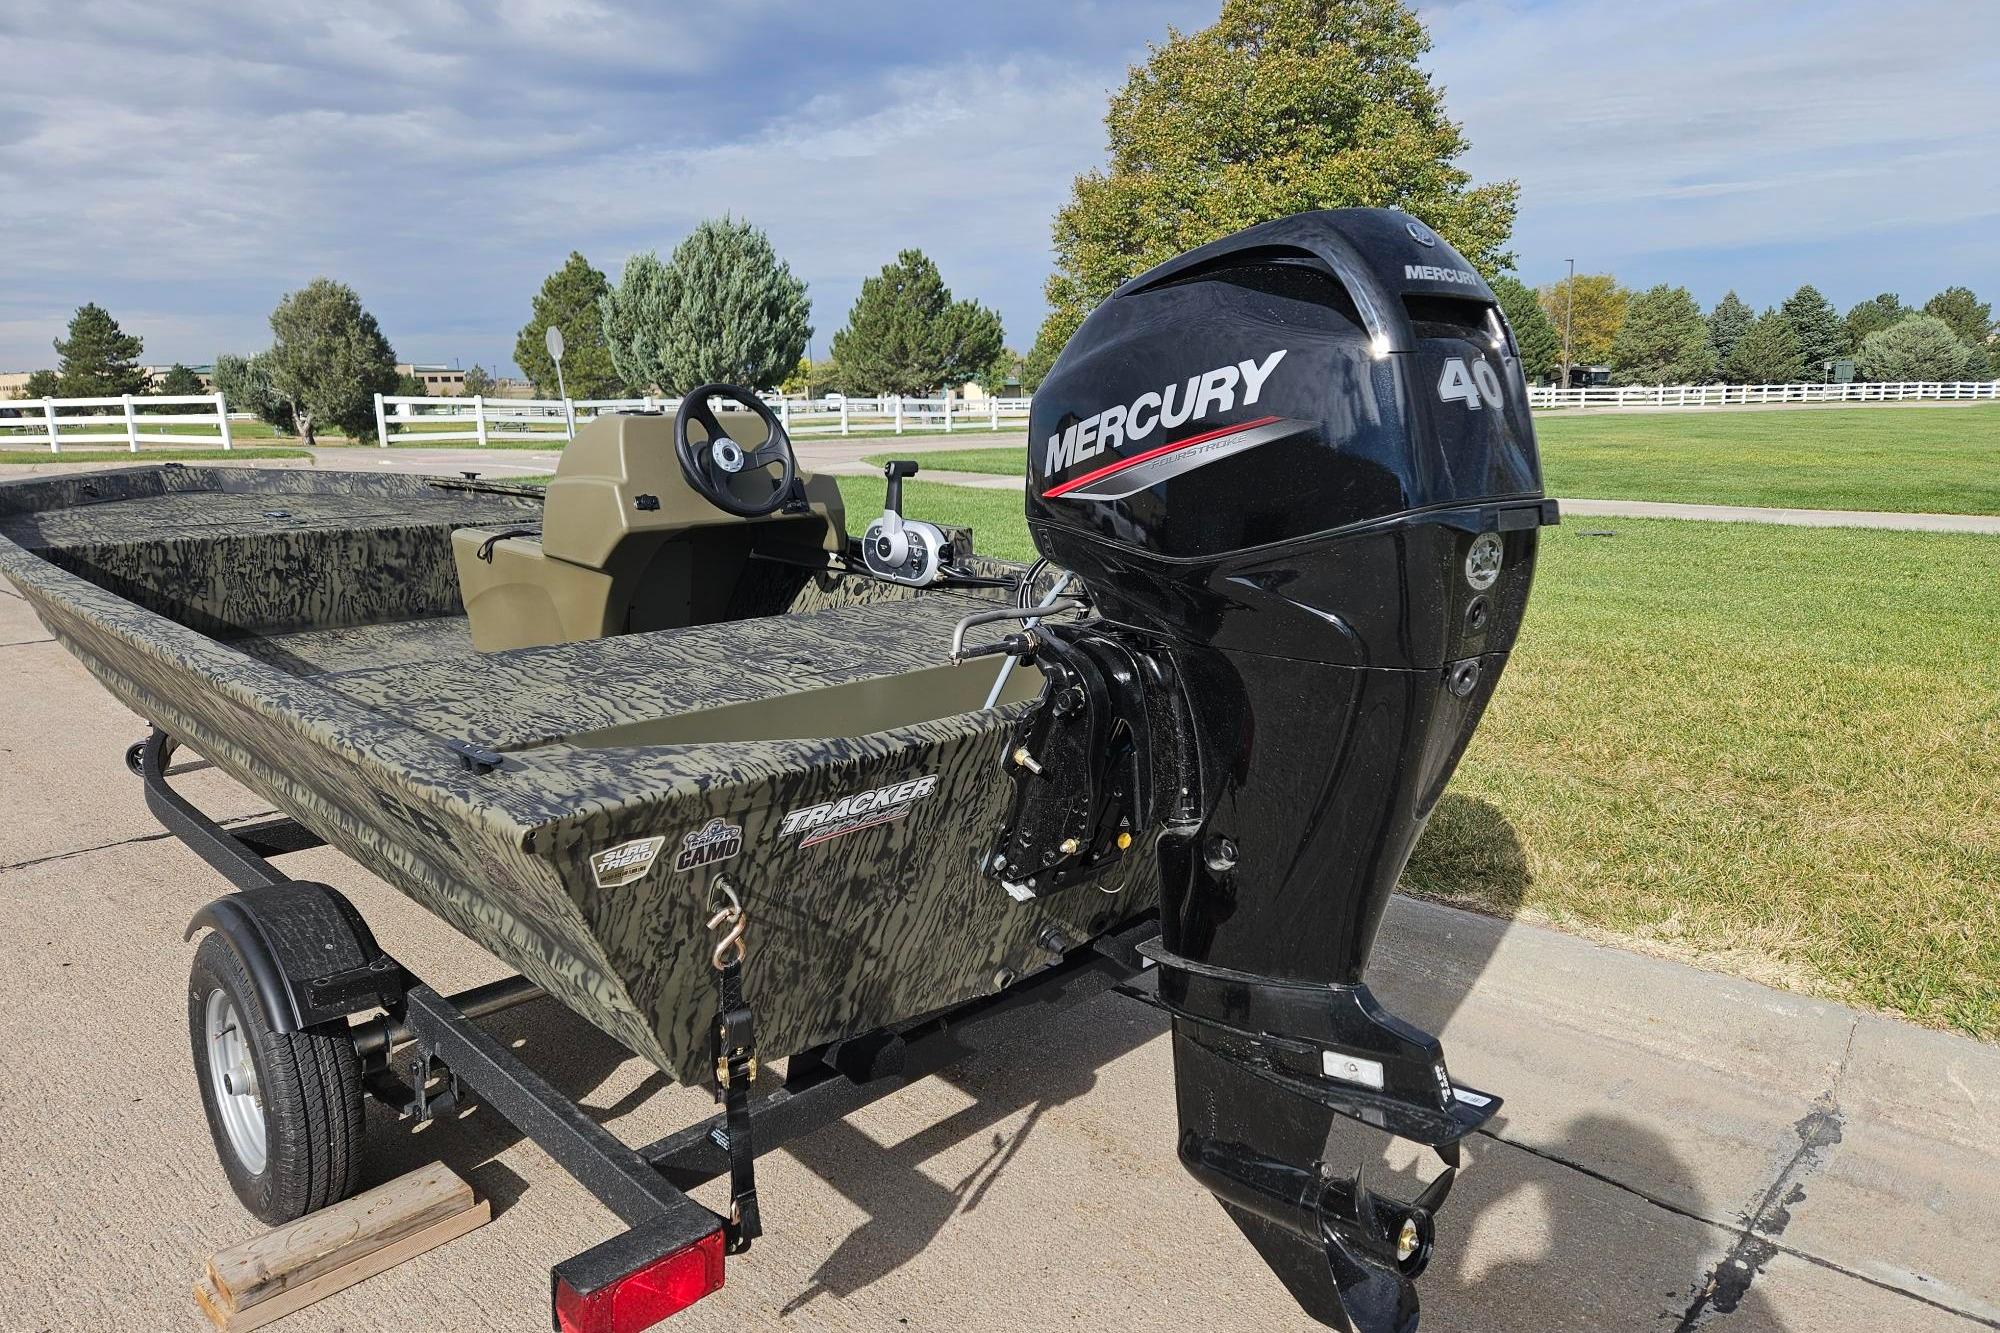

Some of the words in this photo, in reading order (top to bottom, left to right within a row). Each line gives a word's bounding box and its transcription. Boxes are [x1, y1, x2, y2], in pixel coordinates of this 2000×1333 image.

[1404, 265, 1477, 286] MERCURY
[1437, 357, 1504, 411] 40
[1044, 349, 1287, 478] MERCURY
[1150, 433, 1248, 469] FOURSTROKE
[781, 775, 937, 836] TRACKER
[598, 850, 654, 873] TREAD
[602, 841, 652, 863] SURE
[677, 838, 740, 870] CAMO
